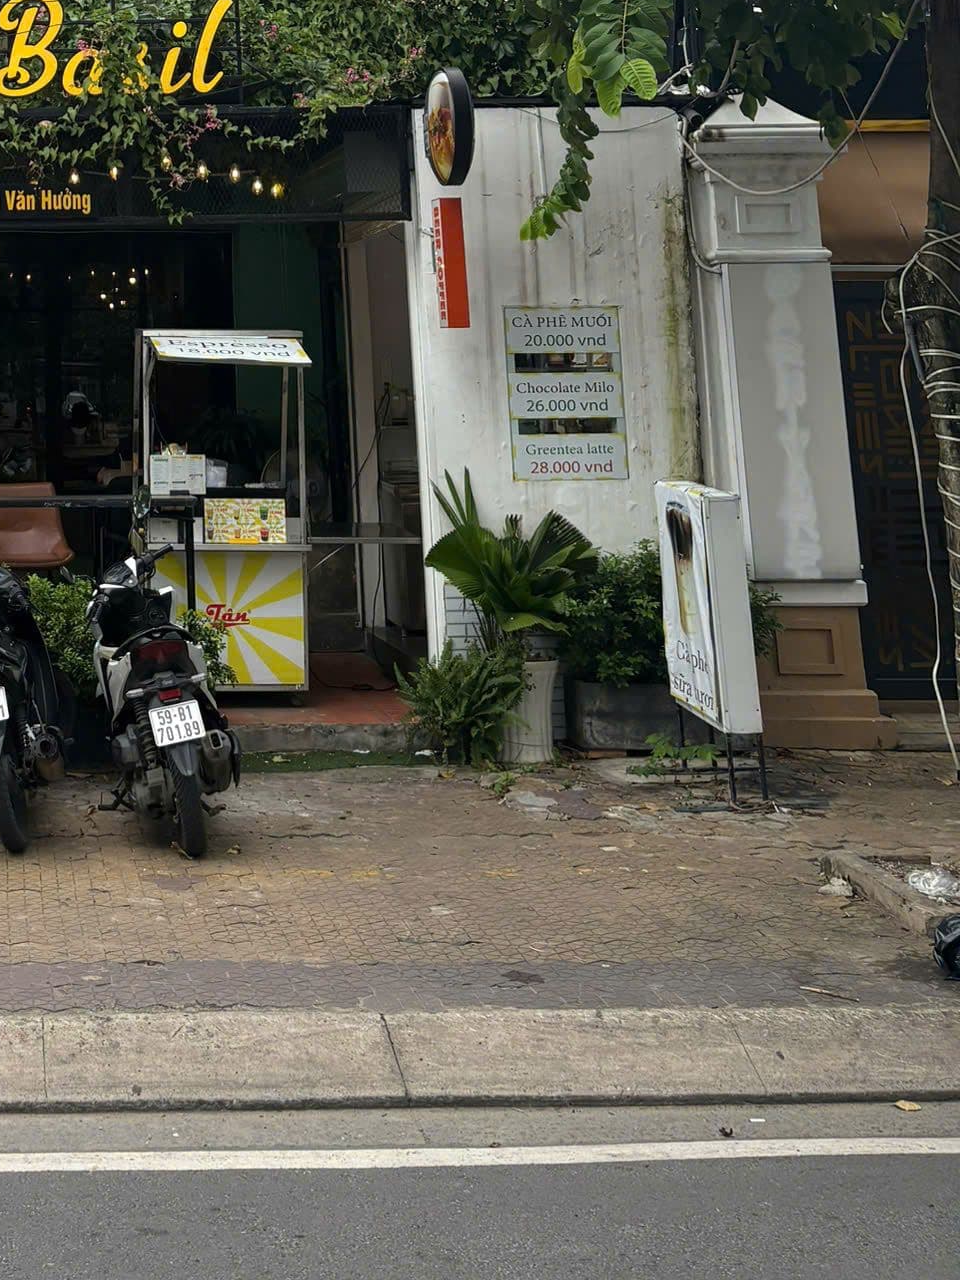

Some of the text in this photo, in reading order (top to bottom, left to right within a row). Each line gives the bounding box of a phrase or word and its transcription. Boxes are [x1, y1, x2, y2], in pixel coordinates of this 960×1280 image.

[5, 190, 35, 211] Văn
[41, 187, 91, 214] Hưởng
[512, 314, 532, 328] CÀ
[536, 314, 568, 327] PHÊ
[167, 339, 288, 349] Espresso
[524, 333, 606, 347] 20.000 vnd
[251, 349, 291, 357] vnd
[516, 381, 615, 394] Chocolate Milo
[526, 398, 609, 412] 26.000 vnd
[525, 443, 614, 455] Greentea latte
[530, 460, 613, 474] 28.000 vnd
[206, 604, 250, 627] Tân
[157, 721, 201, 744] 701.89
